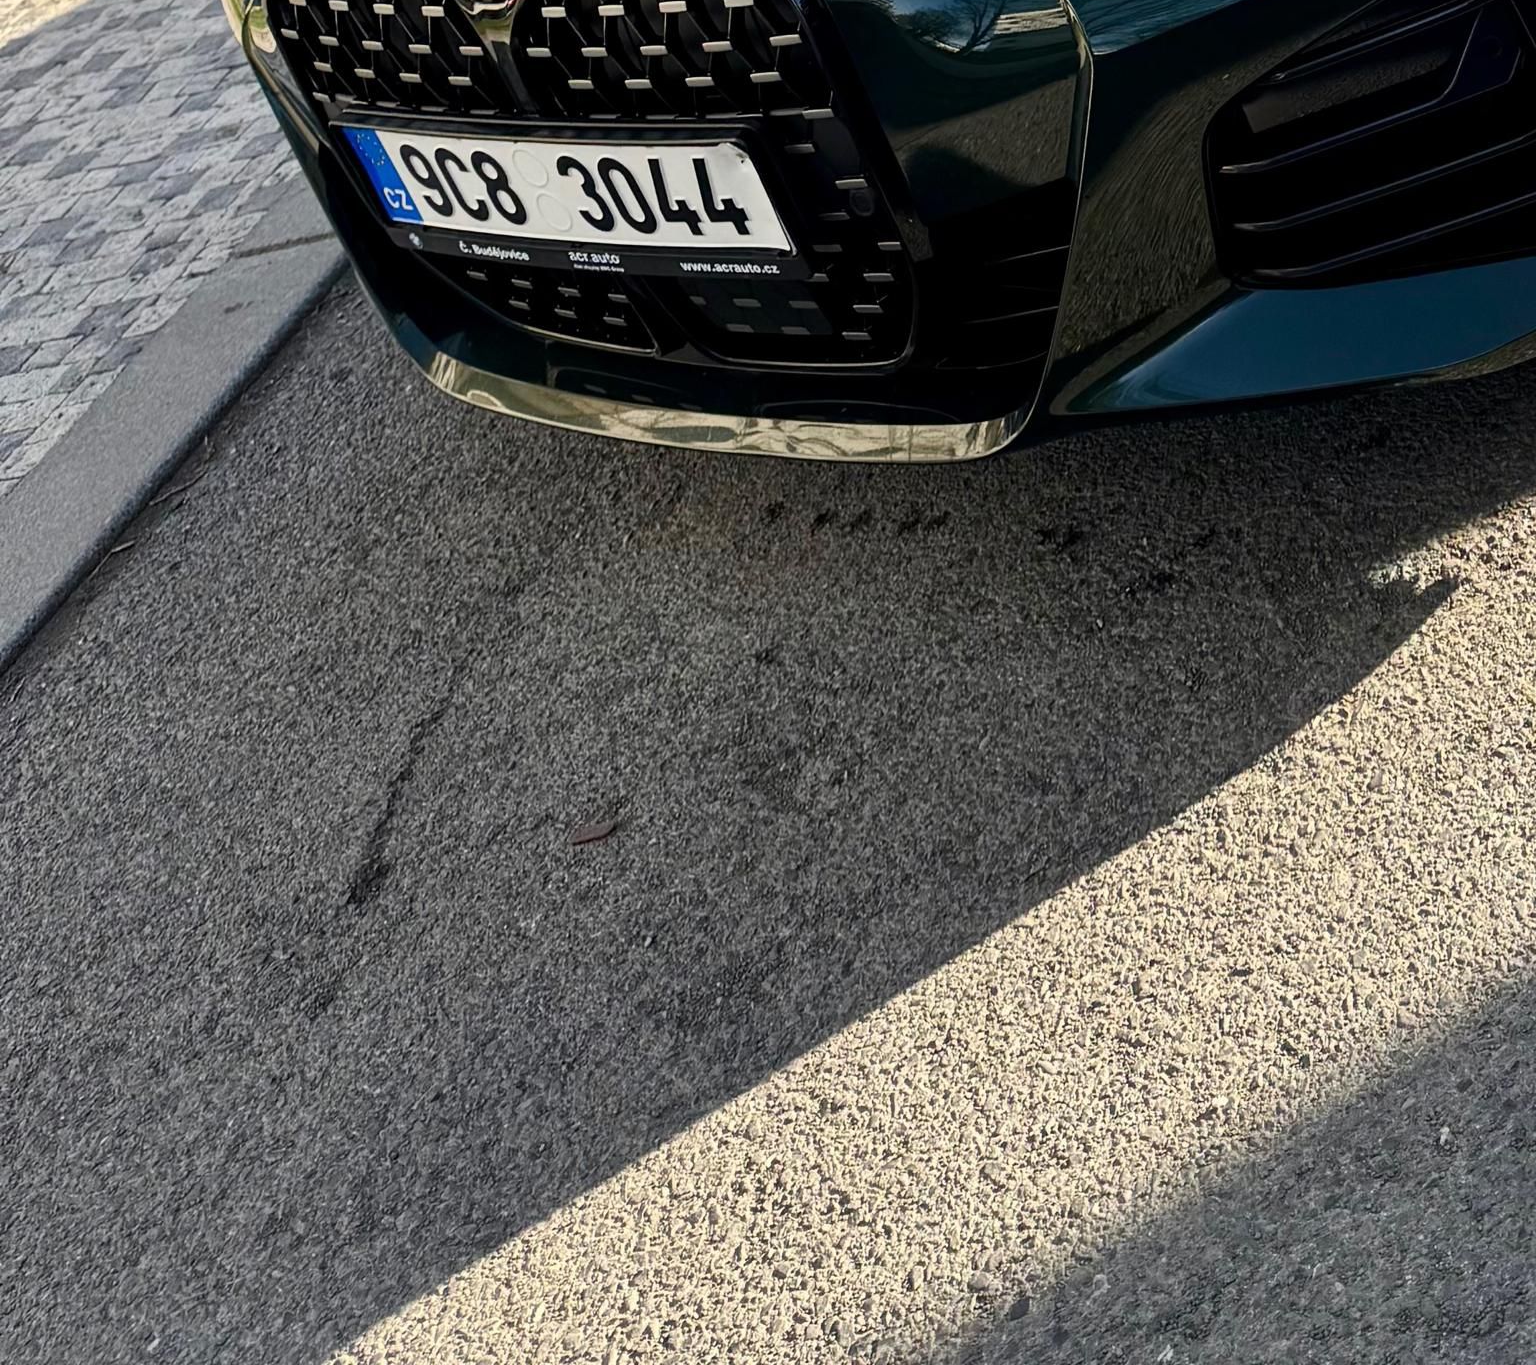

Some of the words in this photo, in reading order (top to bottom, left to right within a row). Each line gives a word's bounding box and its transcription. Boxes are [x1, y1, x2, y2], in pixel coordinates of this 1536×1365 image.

[383, 187, 414, 211] CZ
[399, 144, 527, 226] 9C8
[556, 155, 751, 236] 3044
[679, 262, 781, 275] www.acrauto.cz
